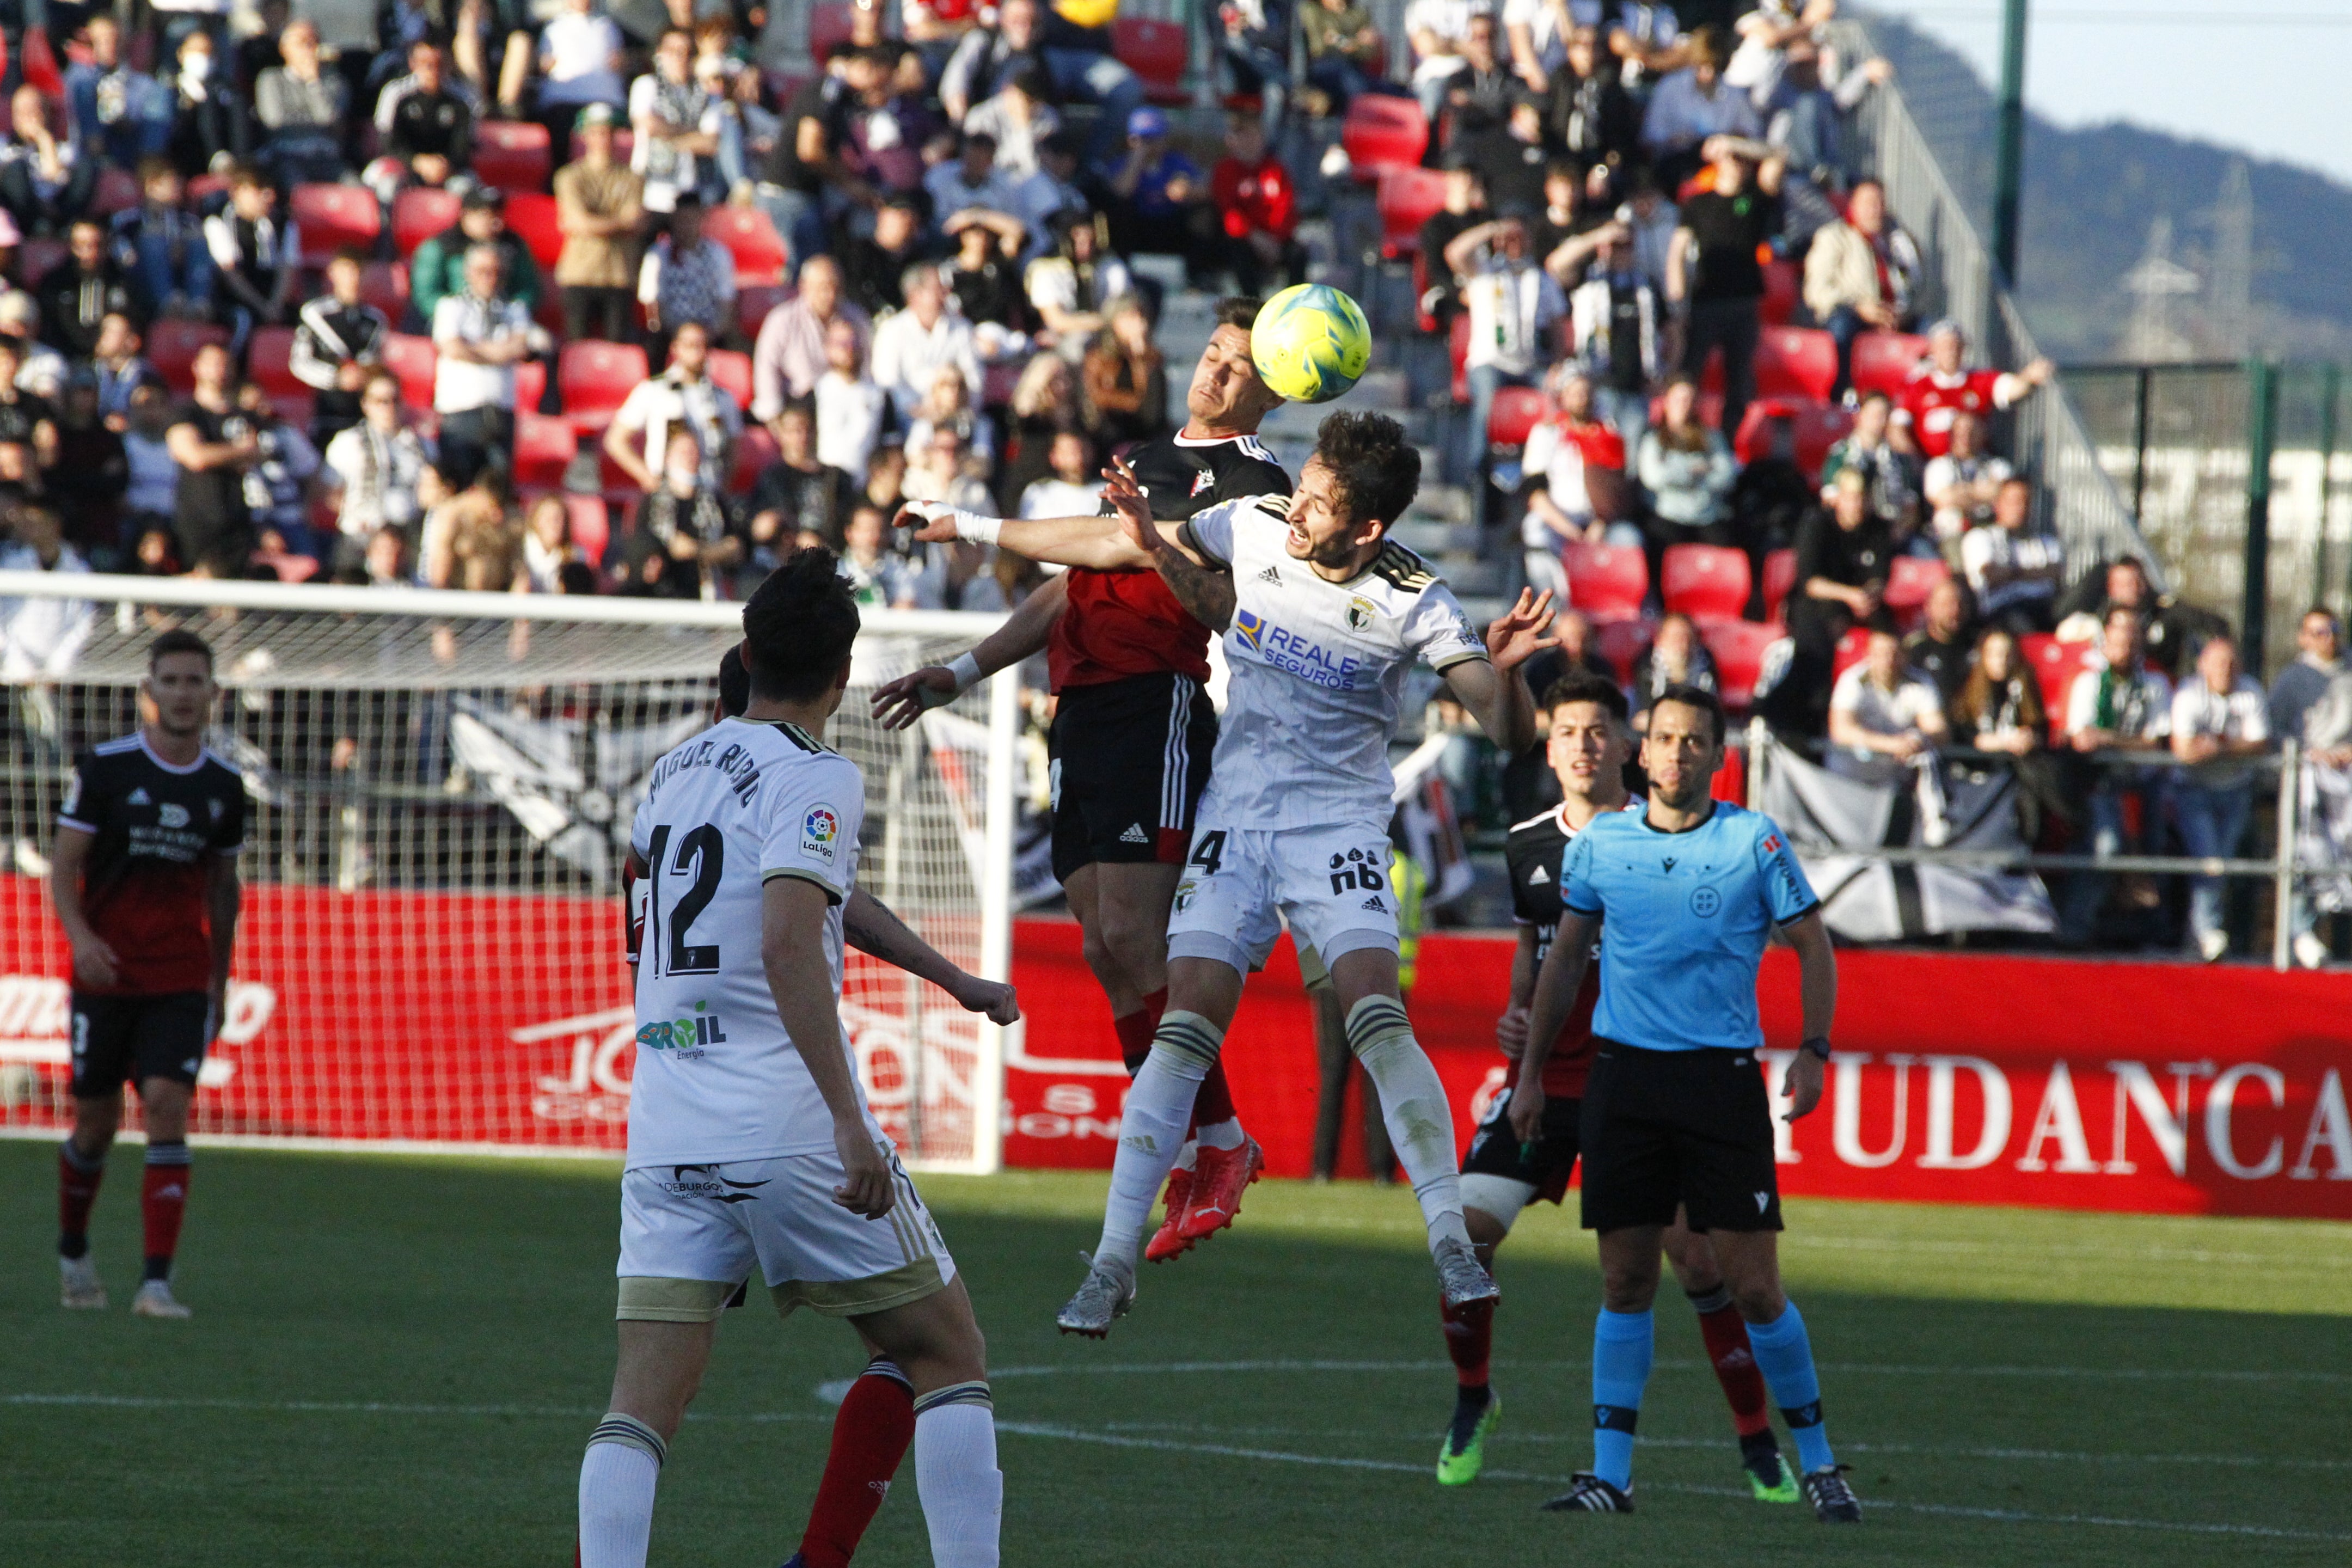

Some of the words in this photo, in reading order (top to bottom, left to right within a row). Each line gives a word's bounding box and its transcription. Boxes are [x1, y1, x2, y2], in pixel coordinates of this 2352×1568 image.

[1265, 648, 1355, 690] SEGUROS
[1269, 627, 1360, 676] REALE
[649, 740, 716, 805] MIGUEL
[803, 841, 832, 857] LaLiga
[1187, 829, 1228, 877] 4
[1330, 862, 1384, 896] nb
[649, 822, 724, 980] 12
[1361, 904, 1388, 915] adidas
[677, 1048, 705, 1061] Energía
